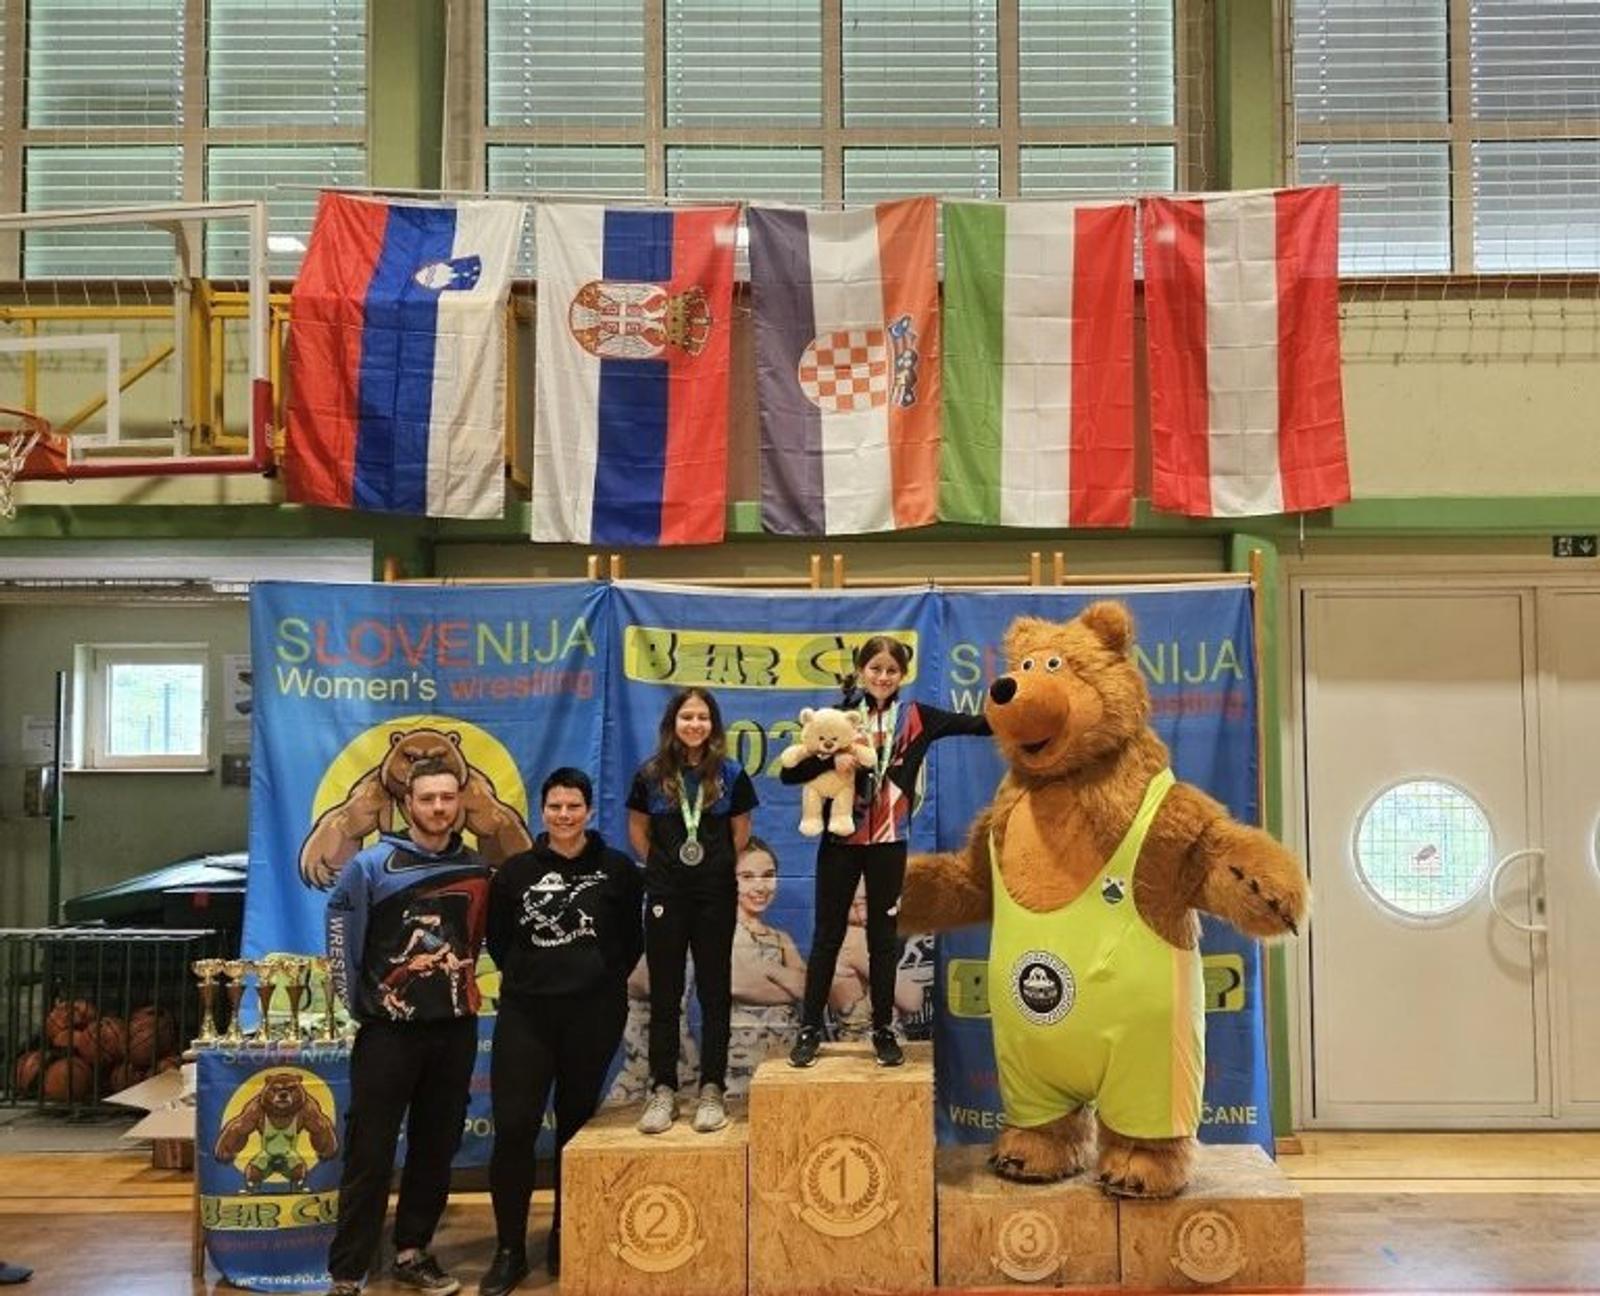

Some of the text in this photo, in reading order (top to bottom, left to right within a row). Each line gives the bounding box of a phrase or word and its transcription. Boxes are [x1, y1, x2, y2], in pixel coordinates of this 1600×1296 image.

[275, 616, 596, 668] SLOVENIJA
[275, 665, 438, 701] Women's
[829, 1155, 848, 1200] 1
[644, 1201, 669, 1239] 2
[1018, 1223, 1038, 1254] 3
[1199, 1224, 1218, 1252] 3
